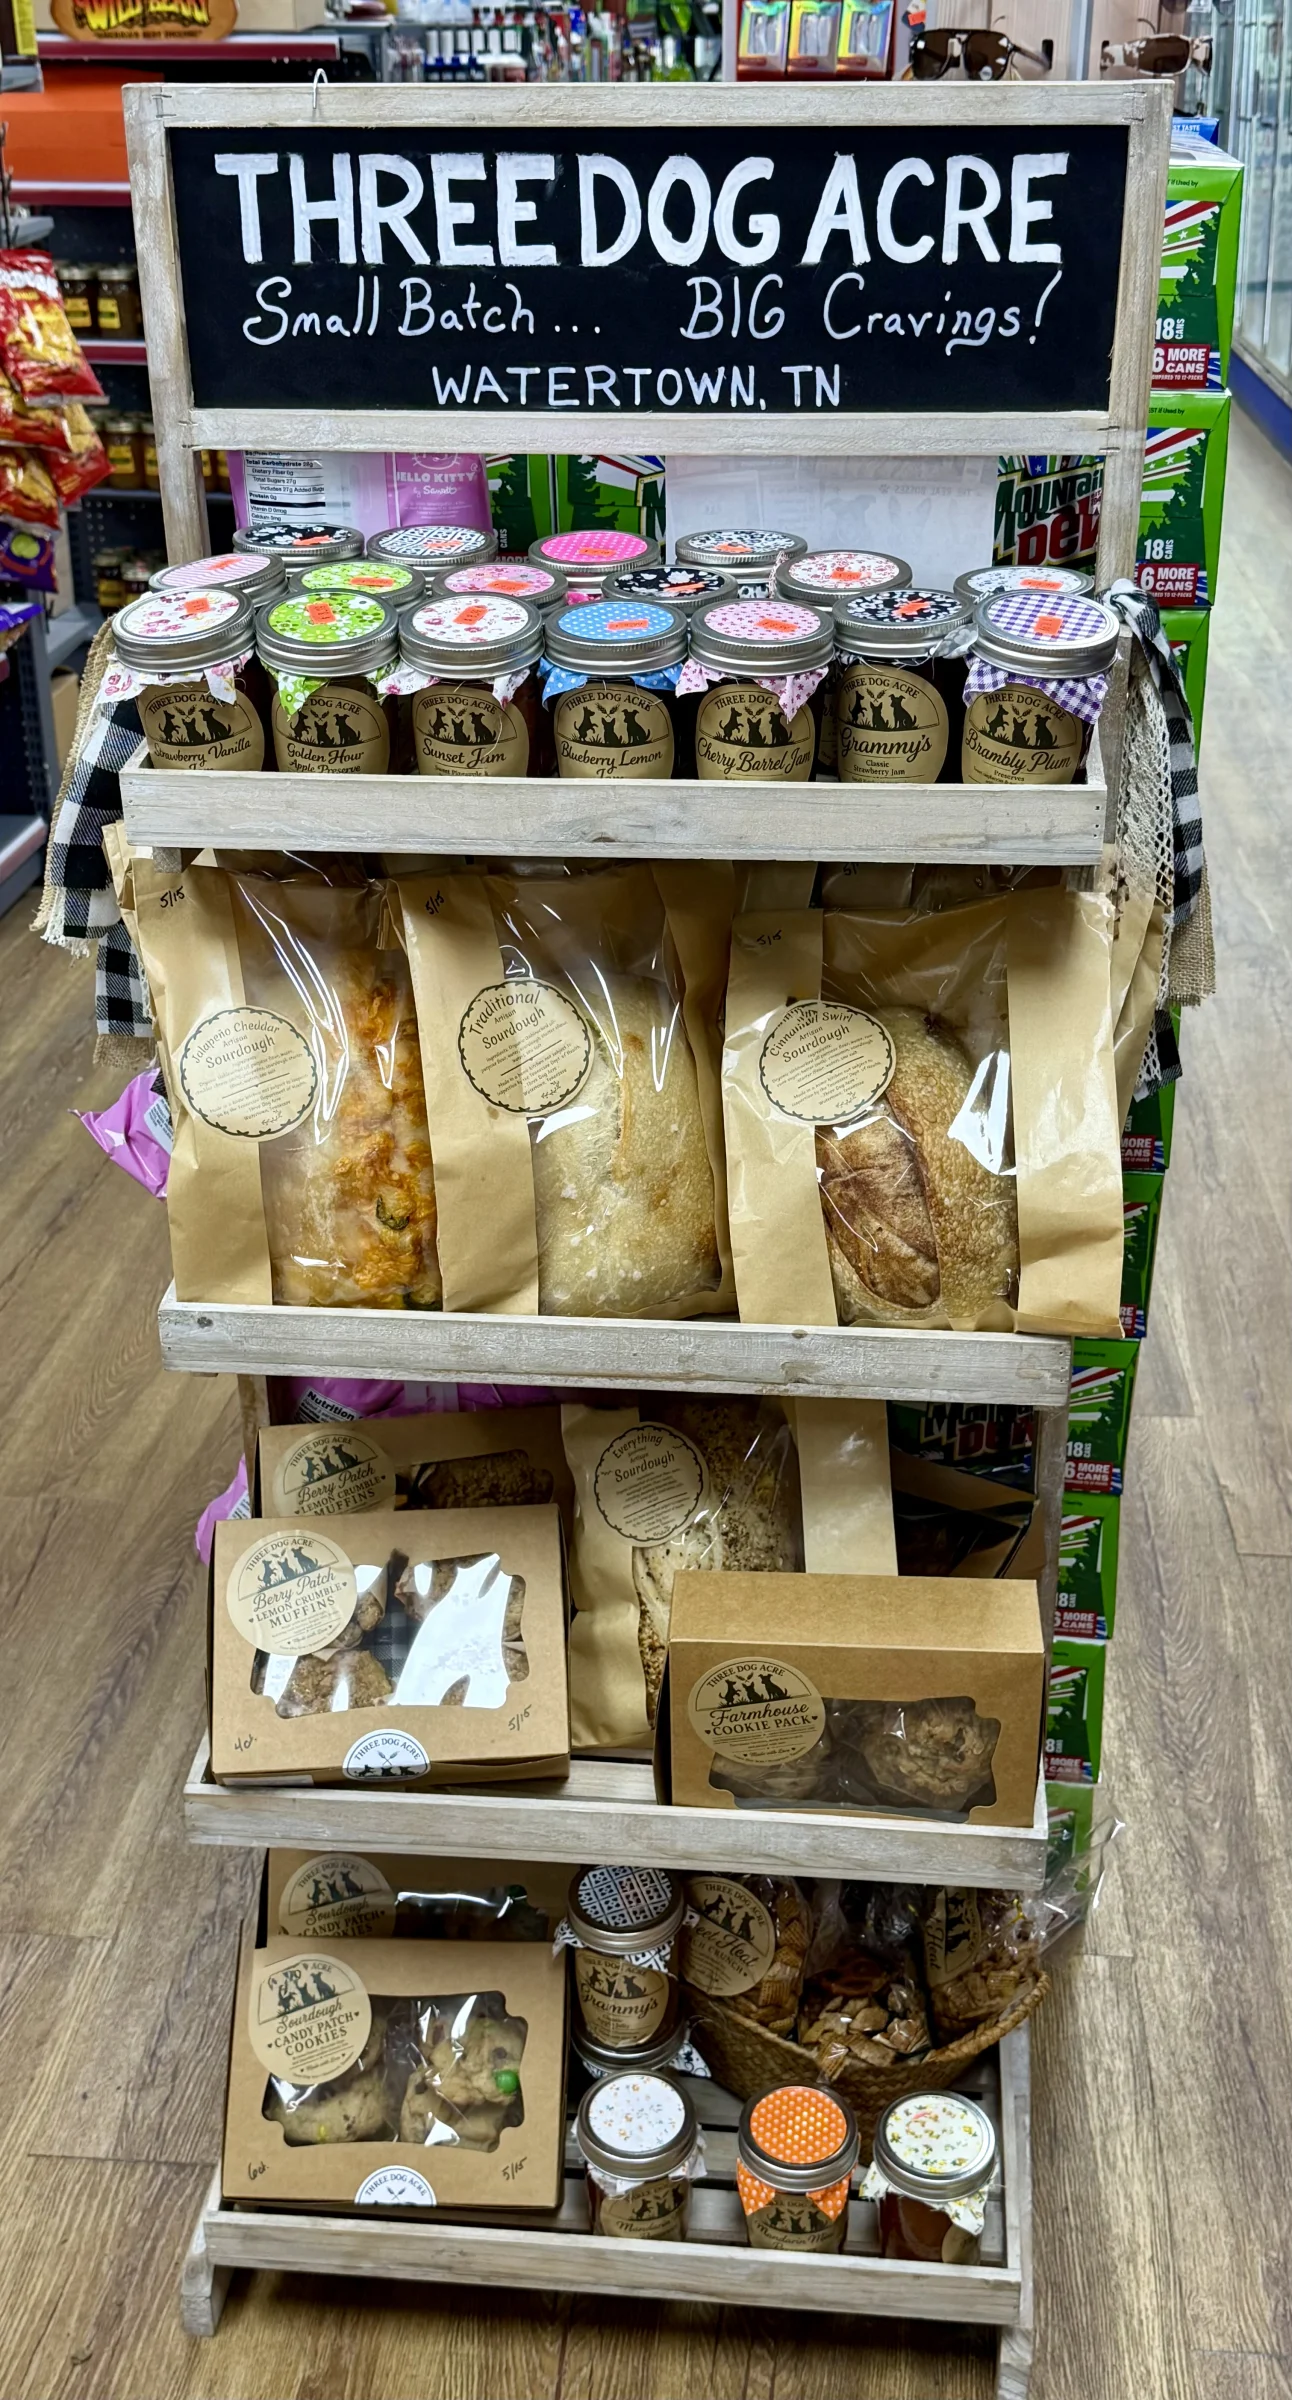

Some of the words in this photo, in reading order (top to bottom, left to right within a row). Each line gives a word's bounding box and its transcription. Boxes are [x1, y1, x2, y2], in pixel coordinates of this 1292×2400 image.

[1182, 124, 1200, 132] TASTE
[1191, 180, 1198, 189] by
[214, 151, 560, 268] THREE
[578, 153, 781, 268] DOG
[800, 150, 1071, 266] ACRE
[242, 275, 381, 346] Small
[681, 273, 785, 340] BIG
[823, 268, 1063, 356] Cravings!
[1155, 318, 1176, 340] 18
[1175, 318, 1185, 340] CANS
[1152, 347, 1165, 373] 6
[1167, 348, 1207, 361] MORE
[1165, 362, 1205, 374] CANS
[432, 364, 767, 411] WATERTOWN,
[781, 363, 842, 408] TN
[262, 459, 301, 467] Carbohydrate
[266, 477, 286, 485] Sugars
[434, 472, 476, 483] KITTY
[499, 528, 508, 548] CANS
[1143, 538, 1165, 560] 18
[1164, 539, 1174, 560] CANS
[1140, 566, 1155, 590] 6
[1157, 567, 1196, 580] MORE
[1155, 581, 1194, 591] CANS
[844, 677, 868, 696] THREE
[868, 677, 890, 687] DOG
[892, 681, 920, 699] ACRE
[148, 695, 174, 714] THREE
[174, 694, 197, 703] DOG
[310, 697, 333, 708] DOG
[335, 699, 362, 716] ACRE
[421, 696, 445, 710] THREE
[447, 695, 469, 706] DOG
[470, 698, 498, 715] ACRE
[565, 692, 596, 712] THREE
[597, 691, 622, 702] DOG
[623, 692, 652, 713] ACRE
[716, 694, 746, 715] THREE
[748, 694, 773, 706] DOG
[984, 692, 1015, 706] THREE
[1016, 694, 1041, 708] DOG
[1040, 701, 1066, 723] ACRE
[154, 743, 208, 767] Strawberry
[208, 737, 252, 760] Vanilla
[286, 743, 327, 763] Golden
[328, 749, 365, 765] Hour
[421, 738, 465, 764] Sunset
[468, 747, 507, 769] Jam
[560, 740, 616, 769] Blueberry
[618, 749, 664, 767] Lemon
[697, 737, 736, 775] Cherry
[736, 751, 785, 773] Barrel
[784, 749, 812, 774] Jam
[840, 727, 933, 763] Grammy's
[965, 728, 1027, 775] Brambly
[1025, 750, 1071, 772] Plum
[853, 764, 890, 777] Strawberry
[890, 767, 906, 776] Jam
[865, 759, 890, 768] Classic
[993, 769, 1025, 783] Preserves
[159, 885, 186, 909] 5/15
[425, 890, 446, 915] 5/15
[469, 989, 541, 1036] Traditional
[494, 1009, 517, 1025] Artisan
[822, 1011, 854, 1023] Swirl
[481, 1006, 546, 1050] Sourdough
[799, 1026, 824, 1042] Artisan
[191, 1027, 232, 1065] Jalapeño
[233, 1019, 281, 1034] Cheddar
[205, 1034, 277, 1070] Sourdough
[223, 1034, 249, 1049] Artisan
[782, 1024, 851, 1063] Sourdough
[307, 1390, 355, 1421] Nutrition
[289, 1442, 313, 1468] THREE
[312, 1436, 331, 1447] DOG
[331, 1436, 353, 1447] ACRE
[612, 1432, 663, 1460] Everything
[1066, 1441, 1083, 1458] 18
[614, 1450, 675, 1483] Sourdough
[1065, 1461, 1076, 1479] 6
[1077, 1462, 1111, 1474] MORE
[1076, 1472, 1109, 1482] CANS
[298, 1480, 337, 1505] Berry
[338, 1463, 377, 1491] Patch
[300, 1495, 337, 1516] LEMON
[338, 1475, 382, 1501] CRUMBLE
[313, 1488, 377, 1518] MUFFINS
[245, 1547, 271, 1572] THREE
[271, 1539, 290, 1551] DOG
[290, 1538, 315, 1548] ACRE
[253, 1588, 294, 1613] Berry
[296, 1566, 337, 1596] Patch
[255, 1602, 294, 1622] LEMON
[295, 1582, 342, 1607] CRUMBLE
[269, 1595, 336, 1629] MUFFINS
[1061, 1620, 1094, 1629] CANS
[1063, 1611, 1095, 1622] MORE
[706, 1667, 736, 1688] THREE
[736, 1663, 758, 1673] DOG
[759, 1664, 786, 1677] ACRE
[508, 1704, 533, 1732] 5/15
[709, 1702, 810, 1728] Farmhouse
[712, 1720, 771, 1736] COOKIE
[775, 1714, 812, 1729] PACK
[354, 1739, 381, 1762] THREE
[381, 1738, 402, 1748] DOG
[400, 1741, 421, 1762] ACRE
[305, 1900, 371, 1927] Sourdough
[704, 1883, 734, 1896] THREE
[733, 1891, 752, 1907] DOG
[749, 1901, 767, 1928] ACRE
[302, 1922, 343, 1938] CANDY
[344, 1909, 380, 1929] PATCH
[712, 1945, 745, 1976] CRUNCH
[716, 1931, 757, 1968] Heat
[310, 1962, 334, 1973] ACRE
[580, 1981, 660, 2020] Grammy's
[273, 2026, 315, 2048] CANDY
[316, 2010, 355, 2033] PATCH
[276, 1996, 344, 2036] Sourdough
[285, 2025, 348, 2056] COOKIES
[501, 2156, 529, 2182] 5/15
[364, 2174, 391, 2196] THREE
[389, 2172, 409, 2183] DOG
[407, 2175, 428, 2196] ACRE
[755, 2221, 807, 2246] Mandarin
